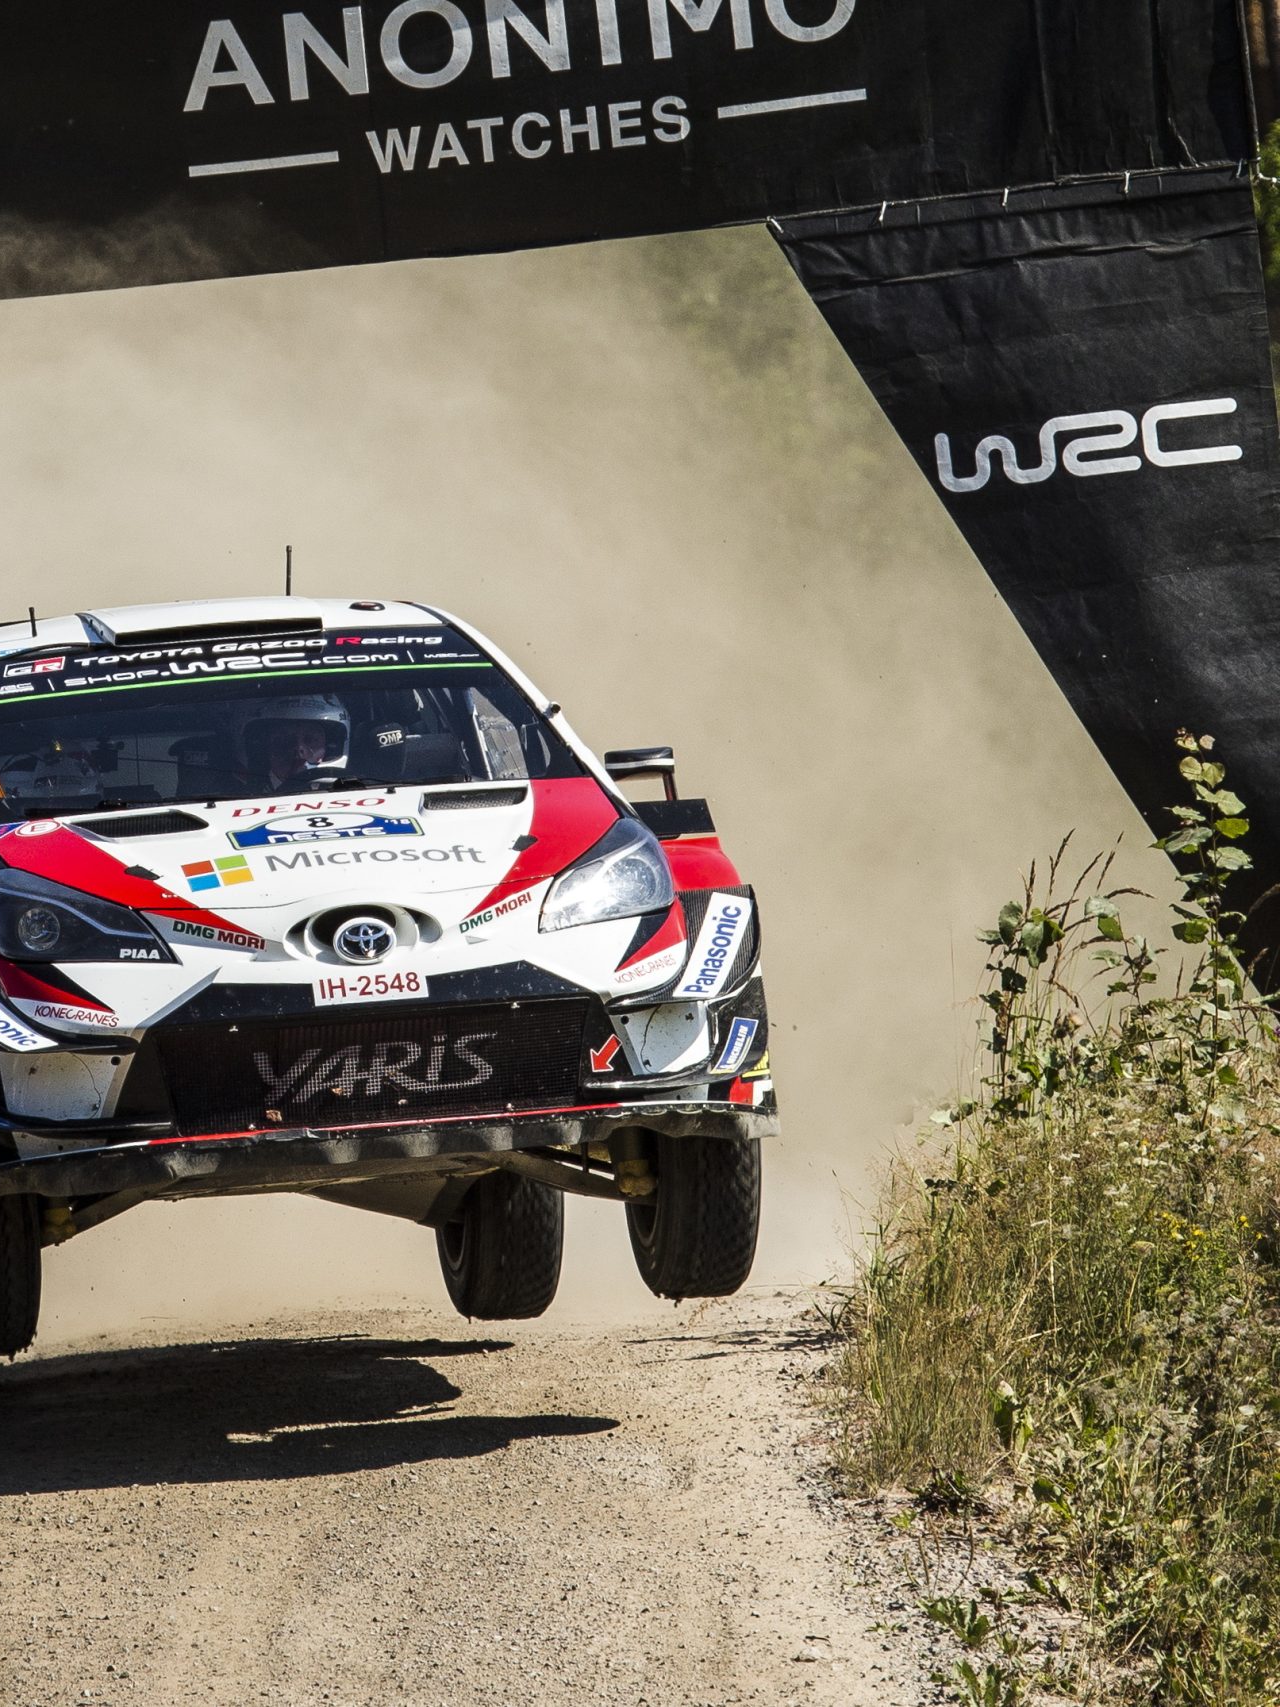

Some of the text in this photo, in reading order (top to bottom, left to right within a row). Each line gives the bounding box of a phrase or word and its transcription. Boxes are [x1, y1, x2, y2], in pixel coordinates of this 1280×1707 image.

[365, 96, 691, 173] WATCHES
[934, 397, 1243, 493] WRC
[74, 635, 443, 667] TOYOTA GAZOO Racing
[5, 660, 63, 677] GR
[379, 732, 402, 746] OMP
[231, 798, 385, 817] DENSO
[267, 826, 387, 844] NESTE
[306, 816, 334, 828] 8
[265, 845, 486, 872] Microsoft
[459, 892, 532, 934] DMG MORI
[173, 920, 265, 950] DMG MORI
[120, 949, 160, 960] PIAA
[683, 906, 741, 993] Panasonic
[615, 954, 676, 984] KONECRANES
[320, 972, 420, 999] IH-2548
[34, 1004, 119, 1028] KONECRANES
